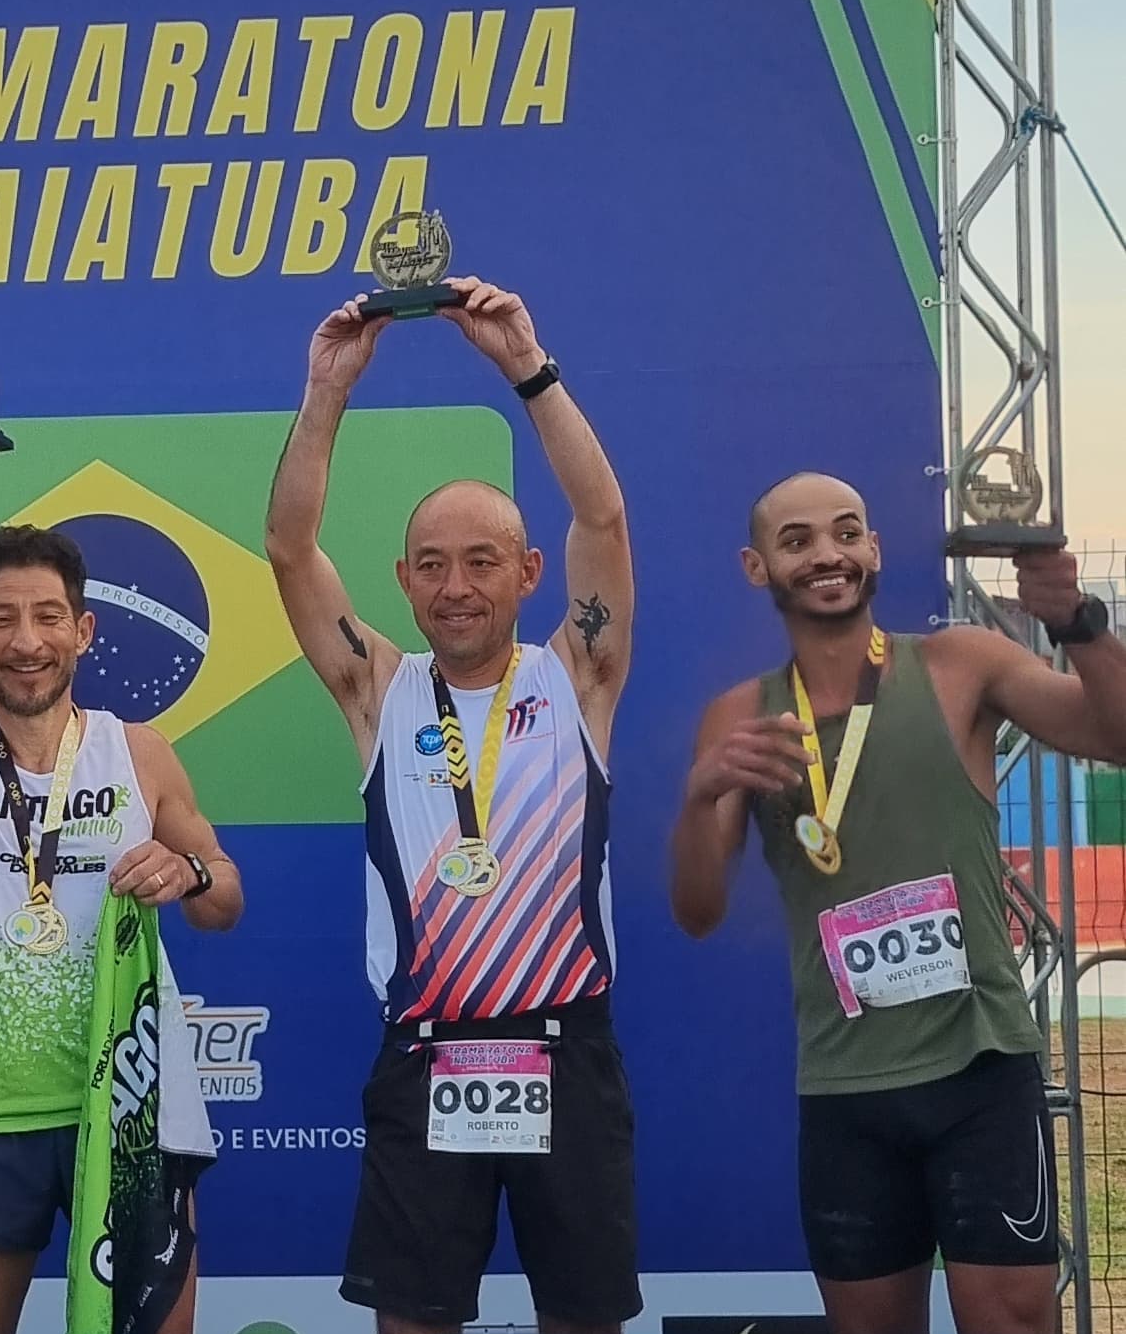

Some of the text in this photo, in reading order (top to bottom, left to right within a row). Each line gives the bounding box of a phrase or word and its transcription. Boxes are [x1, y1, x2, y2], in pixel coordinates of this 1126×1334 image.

[101, 586, 206, 646] PROGRESSO
[843, 915, 964, 974] 0030
[886, 959, 954, 983] WEVERSON
[433, 1080, 549, 1115] 0028
[232, 1129, 244, 1149] E
[253, 1127, 367, 1149] EVENTOS
[467, 1121, 519, 1131] ROBERTO
